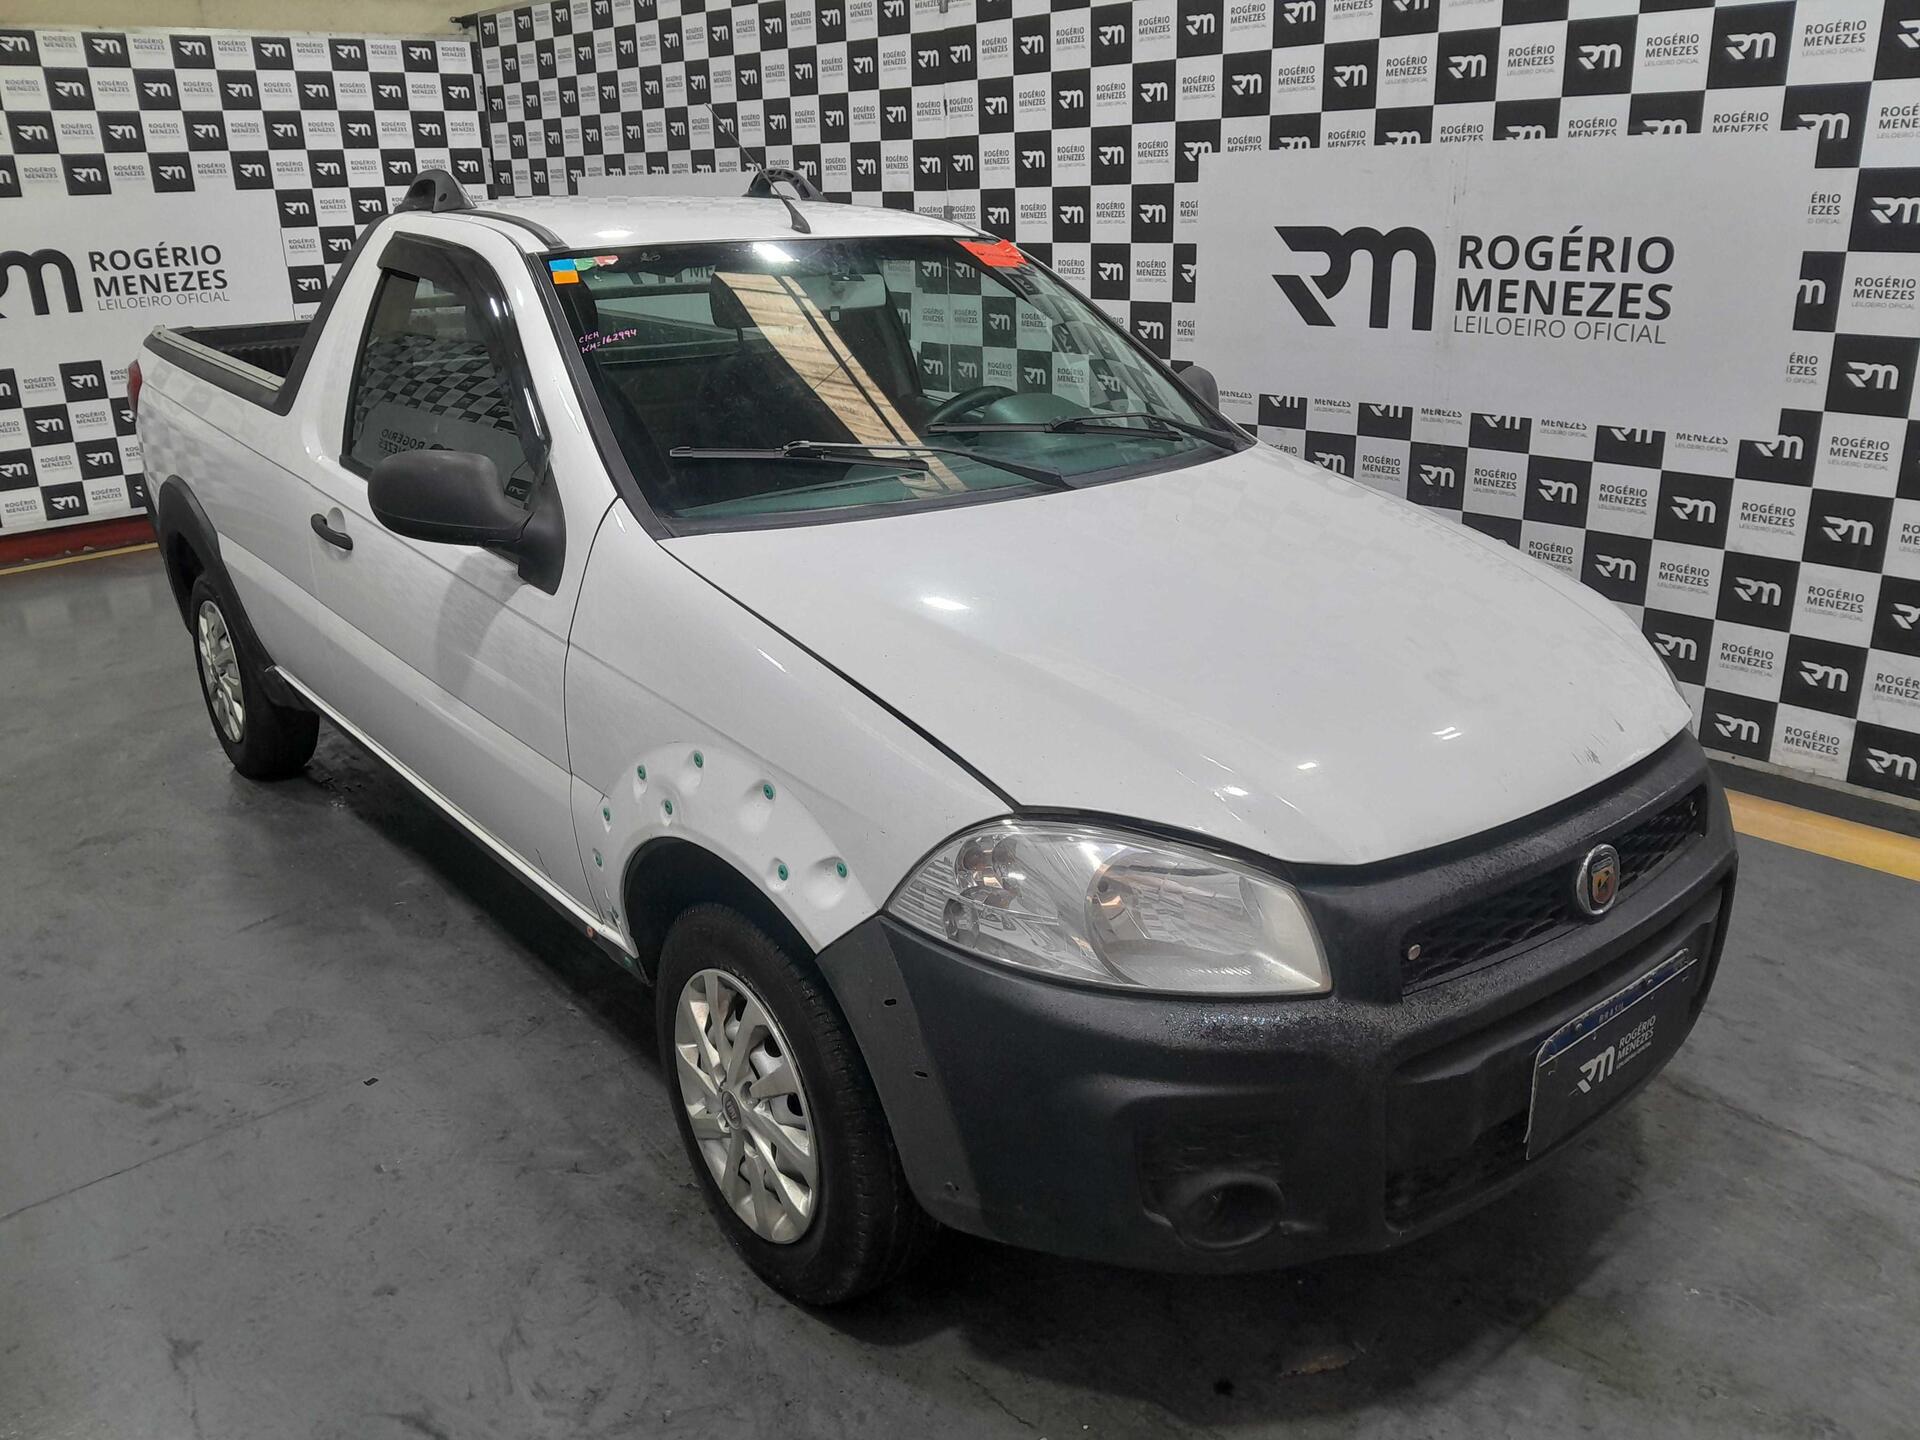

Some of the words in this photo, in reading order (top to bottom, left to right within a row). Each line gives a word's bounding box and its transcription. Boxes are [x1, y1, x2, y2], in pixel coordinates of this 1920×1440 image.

[1231, 3, 1266, 15] ROGÉRIO
[1139, 15, 1170, 26] ROGÉRIO
[1231, 13, 1266, 24] MENEZES
[1056, 26, 1084, 36] ROGÉRIO
[1139, 25, 1170, 37] MENEZES
[1805, 20, 1867, 35] ROGÉRIO
[982, 36, 1007, 46] ROGÉRIO
[1056, 35, 1085, 45] MENEZES
[1647, 32, 1699, 46] ROGÉRIO
[1804, 33, 1865, 47] MENEZES
[982, 45, 1008, 54] MENEZES
[1509, 44, 1555, 57] ROGÉRIO
[1646, 45, 1698, 58] MENEZES
[1387, 55, 1427, 67] ROGÉRIO
[1508, 56, 1554, 67] MENEZES
[1279, 65, 1315, 76] ROGÉRIO
[1386, 66, 1427, 77] MENEZES
[1183, 74, 1215, 84] ROGÉRIO
[1279, 75, 1315, 85] MENEZES
[1097, 82, 1126, 92] ROGÉRIO
[1183, 84, 1215, 93] MENEZES
[1019, 89, 1046, 99] ROGÉRIO
[1097, 91, 1126, 100] MENEZES
[1019, 98, 1046, 107] MENEZES
[1880, 103, 1920, 117] ROGÉ
[1714, 110, 1769, 123] ROGÉRIO
[1441, 122, 1484, 134] ROGÉRIO
[1569, 118, 1617, 129] ROGÉRIO
[1878, 118, 1920, 129] MENE
[1228, 135, 1262, 145] ROGÉRIO
[1328, 130, 1366, 140] ROGÉRIO
[1057, 145, 1085, 154] ROGÉRIO
[1138, 140, 1168, 149] ROGÉRIO
[984, 149, 1009, 157] ROGÉRIO
[1058, 153, 1085, 161] MENEZES
[1138, 149, 1169, 158] MENEZES
[1810, 191, 1841, 204] ÉRIO
[1021, 203, 1046, 211] ROGÉRIO
[1097, 202, 1125, 210] ROGÉRIO
[1808, 205, 1841, 216] EZES
[1458, 225, 1675, 274] ROGÉRIO
[88, 241, 222, 272] ROGÉRIO
[1058, 259, 1085, 267] ROGÉRIO
[1137, 260, 1166, 268] ROGÉRIO
[1057, 267, 1085, 276] MENEZES
[94, 269, 228, 298] MENEZES
[1271, 226, 1436, 331] RM
[1855, 277, 1916, 289] ROGÉRIO
[1454, 278, 1673, 321] MENEZES
[1853, 289, 1915, 300] MENEZES
[97, 294, 172, 311] LEILOEIRO
[176, 291, 230, 305] OFICIAL
[1453, 315, 1566, 338] LEILOEIRO
[1573, 320, 1667, 345] OFICIAL
[1832, 436, 1890, 451] ROGÉRIO
[1363, 454, 1400, 466] ROGÉRIO
[1830, 447, 1888, 462] MENEZES
[1362, 464, 1400, 475] MENEZES
[1475, 468, 1517, 480] ROGÉRIO
[1474, 477, 1516, 490] MENEZES
[1600, 483, 1647, 498] ROGÉRIO
[1599, 493, 1647, 507] MENEZES
[1742, 502, 1796, 517] ROGÉRIO
[1741, 512, 1794, 528] MENEZES
[1529, 540, 1573, 555] ROGÉRIO
[1528, 549, 1573, 565] MENEZES
[1660, 561, 1710, 577] ROGÉRIO
[1659, 572, 1709, 588] MENEZES
[1808, 585, 1864, 603] ROGÉRIO
[1807, 596, 1863, 613] MENEZES
[1722, 642, 1774, 660] ROGÉRIO
[1721, 652, 1773, 670] MENEZES
[1876, 672, 1920, 689] ROGÉR
[1874, 683, 1920, 700] MENEZ
[1786, 726, 1840, 746] ROGÉRIO
[1784, 736, 1838, 755] MENEZES
[1619, 1015, 1656, 1048] ROGÉRIO
[1617, 1027, 1654, 1061] MENEZES
